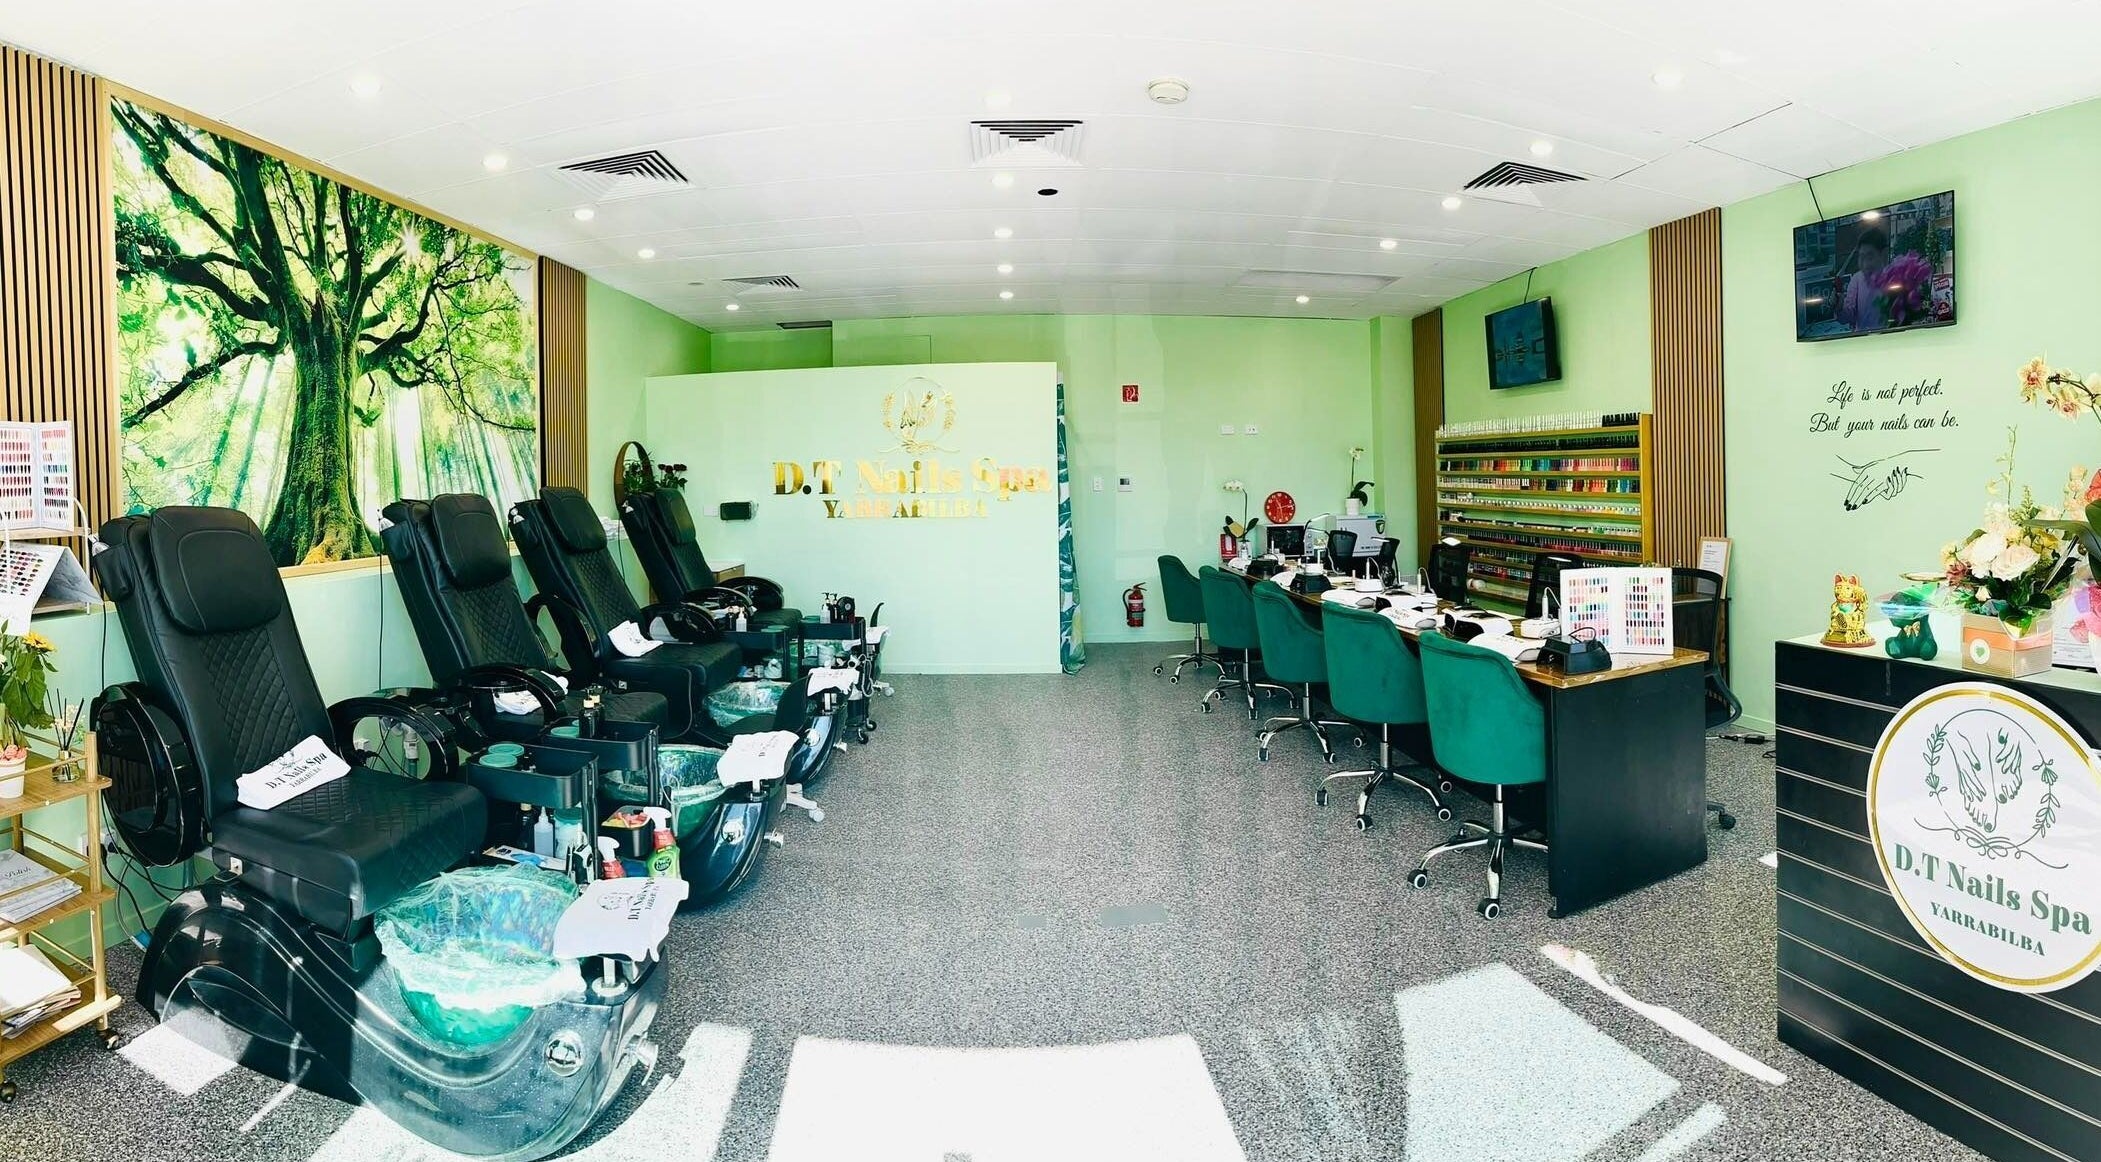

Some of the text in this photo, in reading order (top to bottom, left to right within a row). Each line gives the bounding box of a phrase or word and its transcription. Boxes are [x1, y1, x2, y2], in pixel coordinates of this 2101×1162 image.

[1827, 379, 1943, 409] Life is not perfect.
[1809, 410, 1959, 438] But your nails can be.
[773, 458, 1051, 501] D.T Nails Spa
[823, 499, 987, 519] YARRABILBA
[265, 753, 327, 788] D.T Nails Spa
[1894, 842, 2092, 935] D.T Nails Spa
[1930, 901, 2046, 956] YARRABILBA
